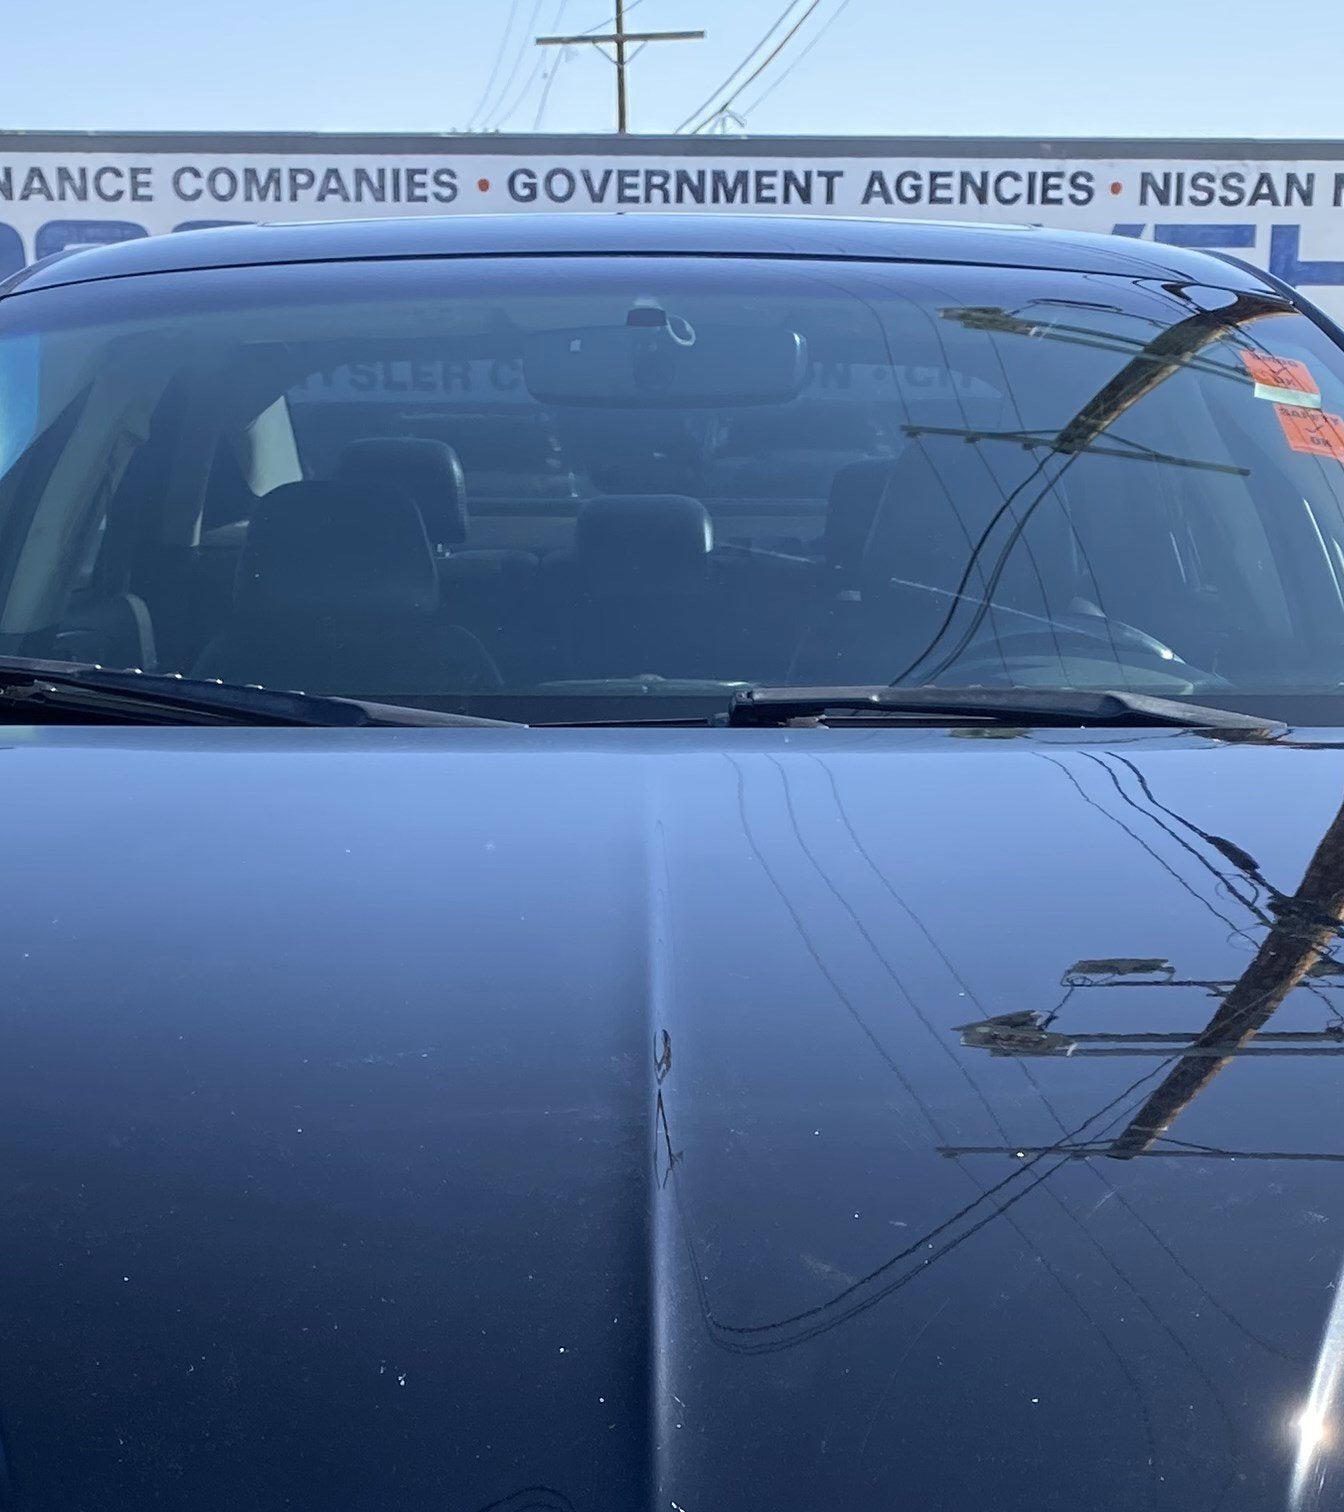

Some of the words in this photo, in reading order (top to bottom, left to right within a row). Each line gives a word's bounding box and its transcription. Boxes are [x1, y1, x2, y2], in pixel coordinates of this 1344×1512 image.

[171, 165, 459, 204] COMPANIES
[506, 167, 844, 205] GOVERNMENT
[859, 169, 1096, 207] AGENCIES
[1138, 171, 1316, 208] NISSAN
